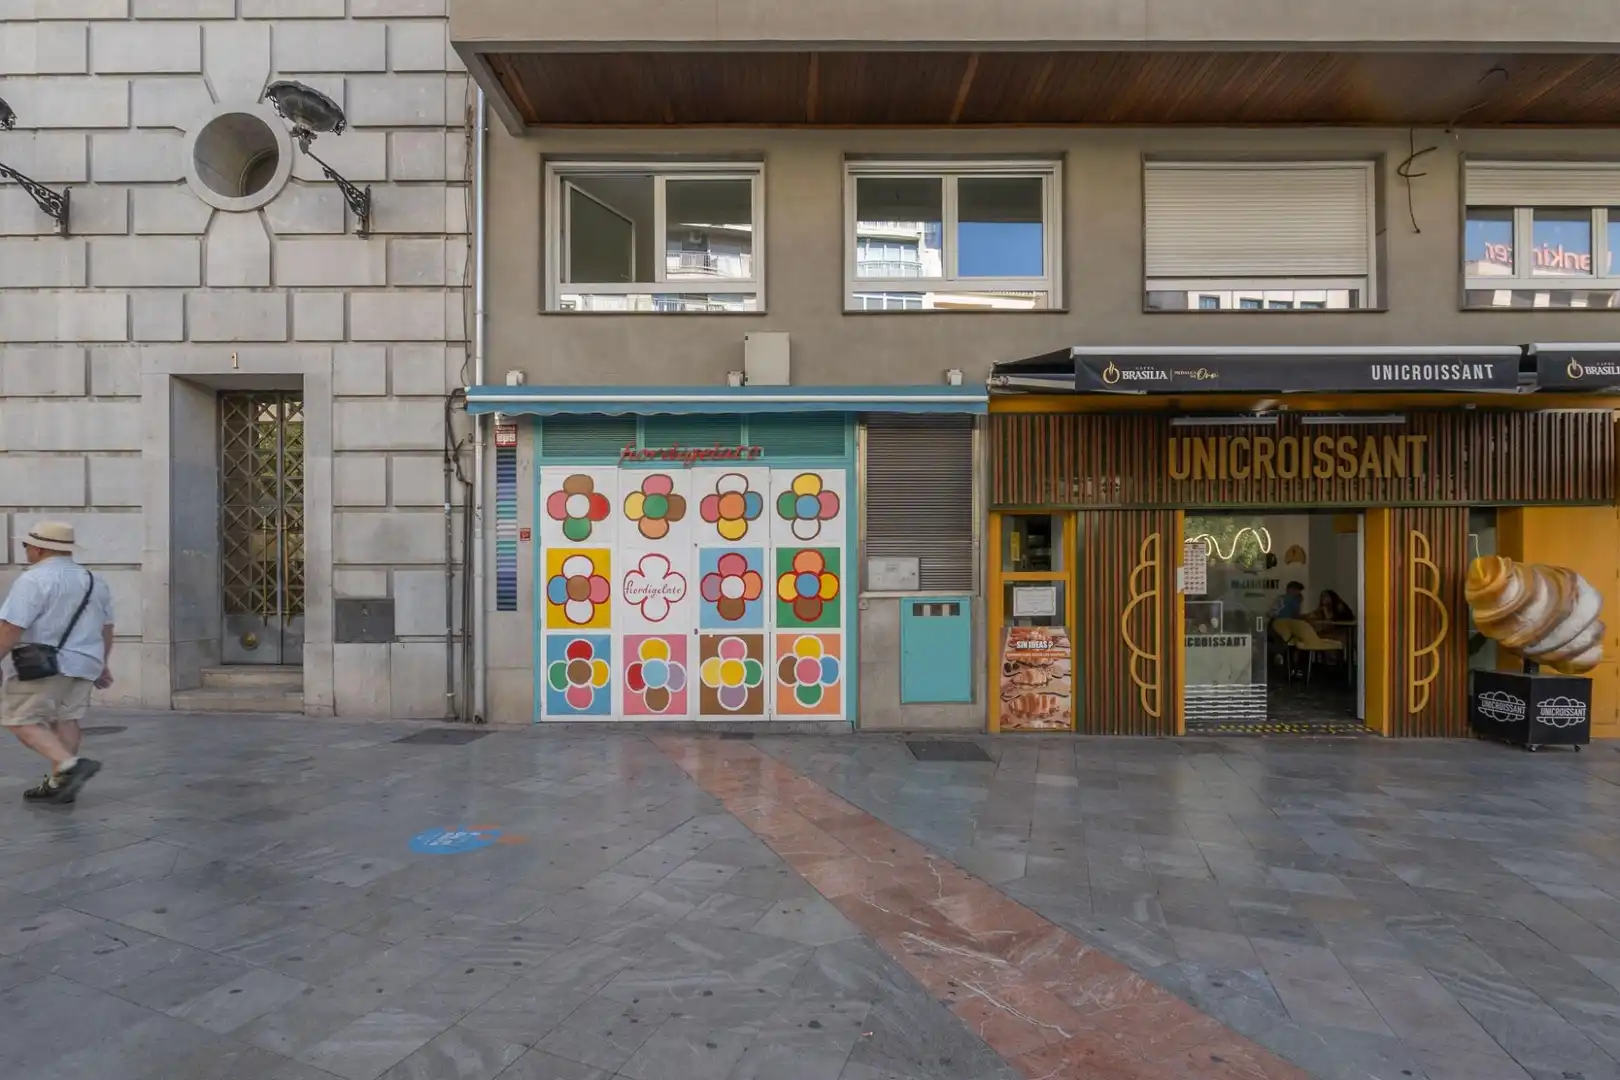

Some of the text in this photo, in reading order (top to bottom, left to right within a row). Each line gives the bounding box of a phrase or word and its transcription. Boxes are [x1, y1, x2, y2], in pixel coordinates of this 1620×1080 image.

[231, 350, 239, 369] 1
[1121, 370, 1168, 380] BRASILIA
[1371, 364, 1493, 380] UNICROISSANT
[1168, 435, 1427, 480] UNICROISSANT
[1481, 699, 1526, 714] UNICROISSANT
[1540, 706, 1586, 717] UNICROISSANT
